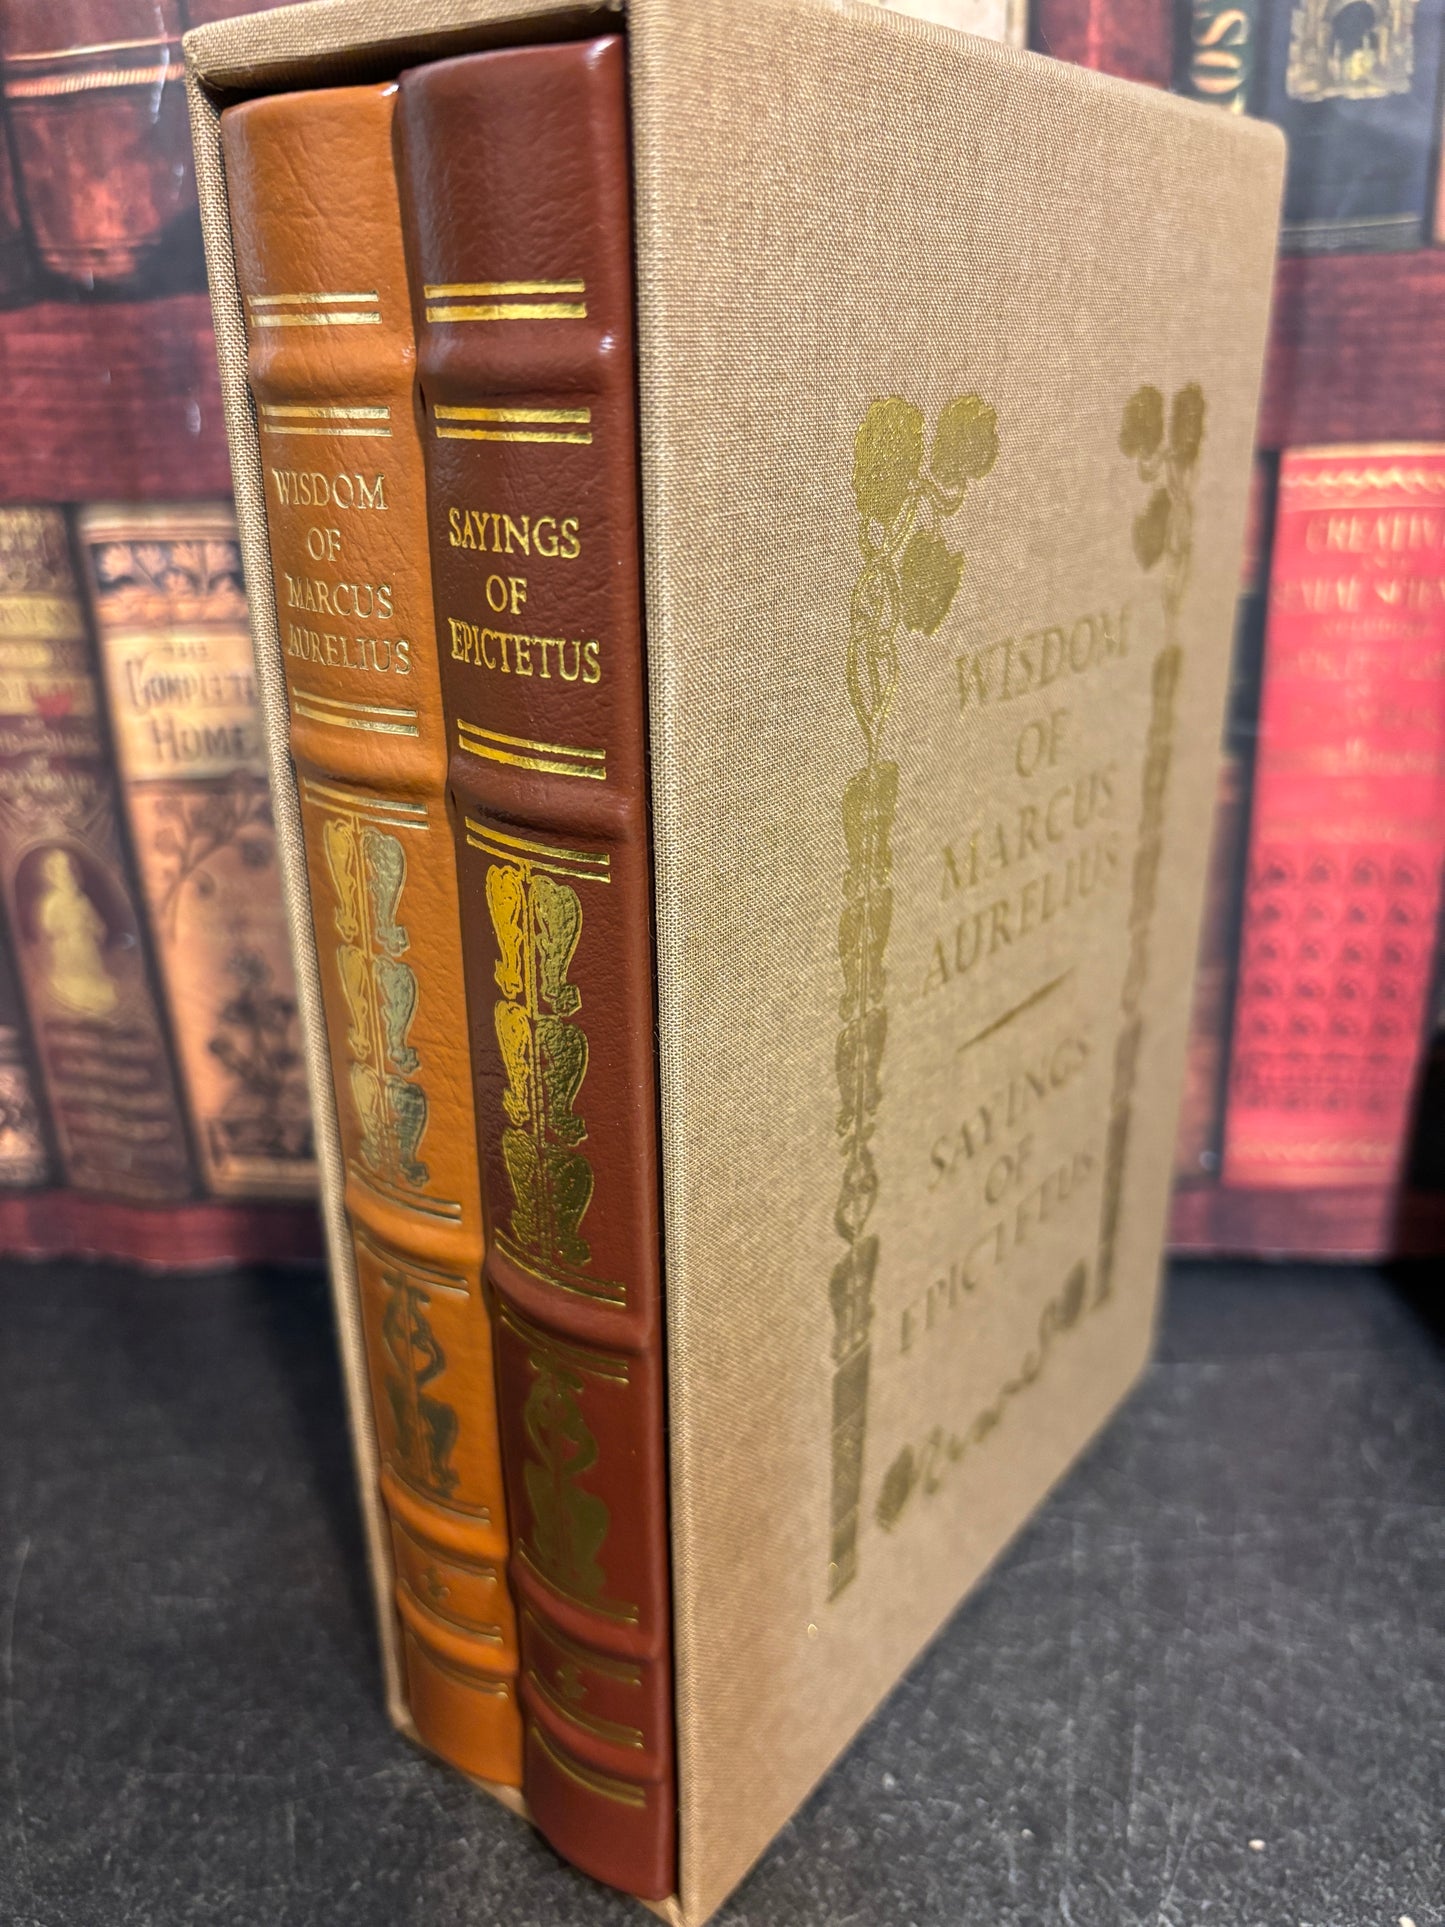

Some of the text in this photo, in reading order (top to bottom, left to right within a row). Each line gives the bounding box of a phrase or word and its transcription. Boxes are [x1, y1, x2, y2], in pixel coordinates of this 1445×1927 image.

[272, 468, 389, 510] WISDOM
[307, 527, 341, 562] OF
[449, 507, 581, 559] SAYINGS
[285, 573, 394, 619] MARCUS
[486, 574, 528, 615] OF
[287, 624, 413, 675] AURELIUS
[448, 617, 601, 684] EPICTETUS
[955, 605, 1131, 718] WISDOM
[1016, 706, 1073, 778] OF
[939, 762, 1118, 900] MARCUS
[921, 830, 1121, 996] AURELIUS
[928, 1036, 1092, 1195] SAYINGS
[985, 1132, 1036, 1205] OF
